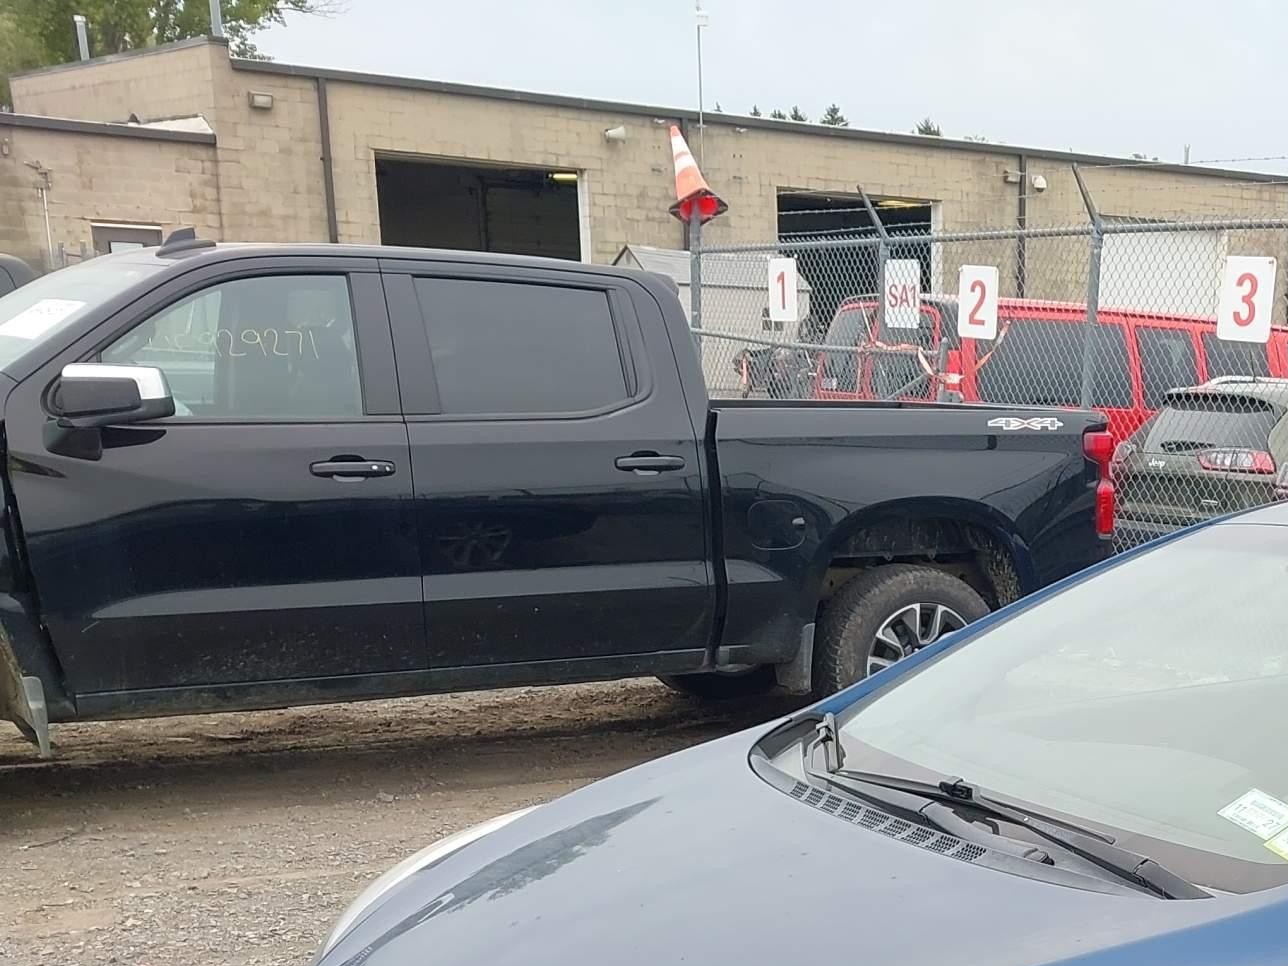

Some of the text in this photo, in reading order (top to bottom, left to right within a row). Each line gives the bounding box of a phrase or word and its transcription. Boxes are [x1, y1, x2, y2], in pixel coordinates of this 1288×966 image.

[776, 271, 786, 310] 1
[888, 284, 917, 309] SA1
[968, 279, 987, 327] 2
[1231, 271, 1260, 329] 3
